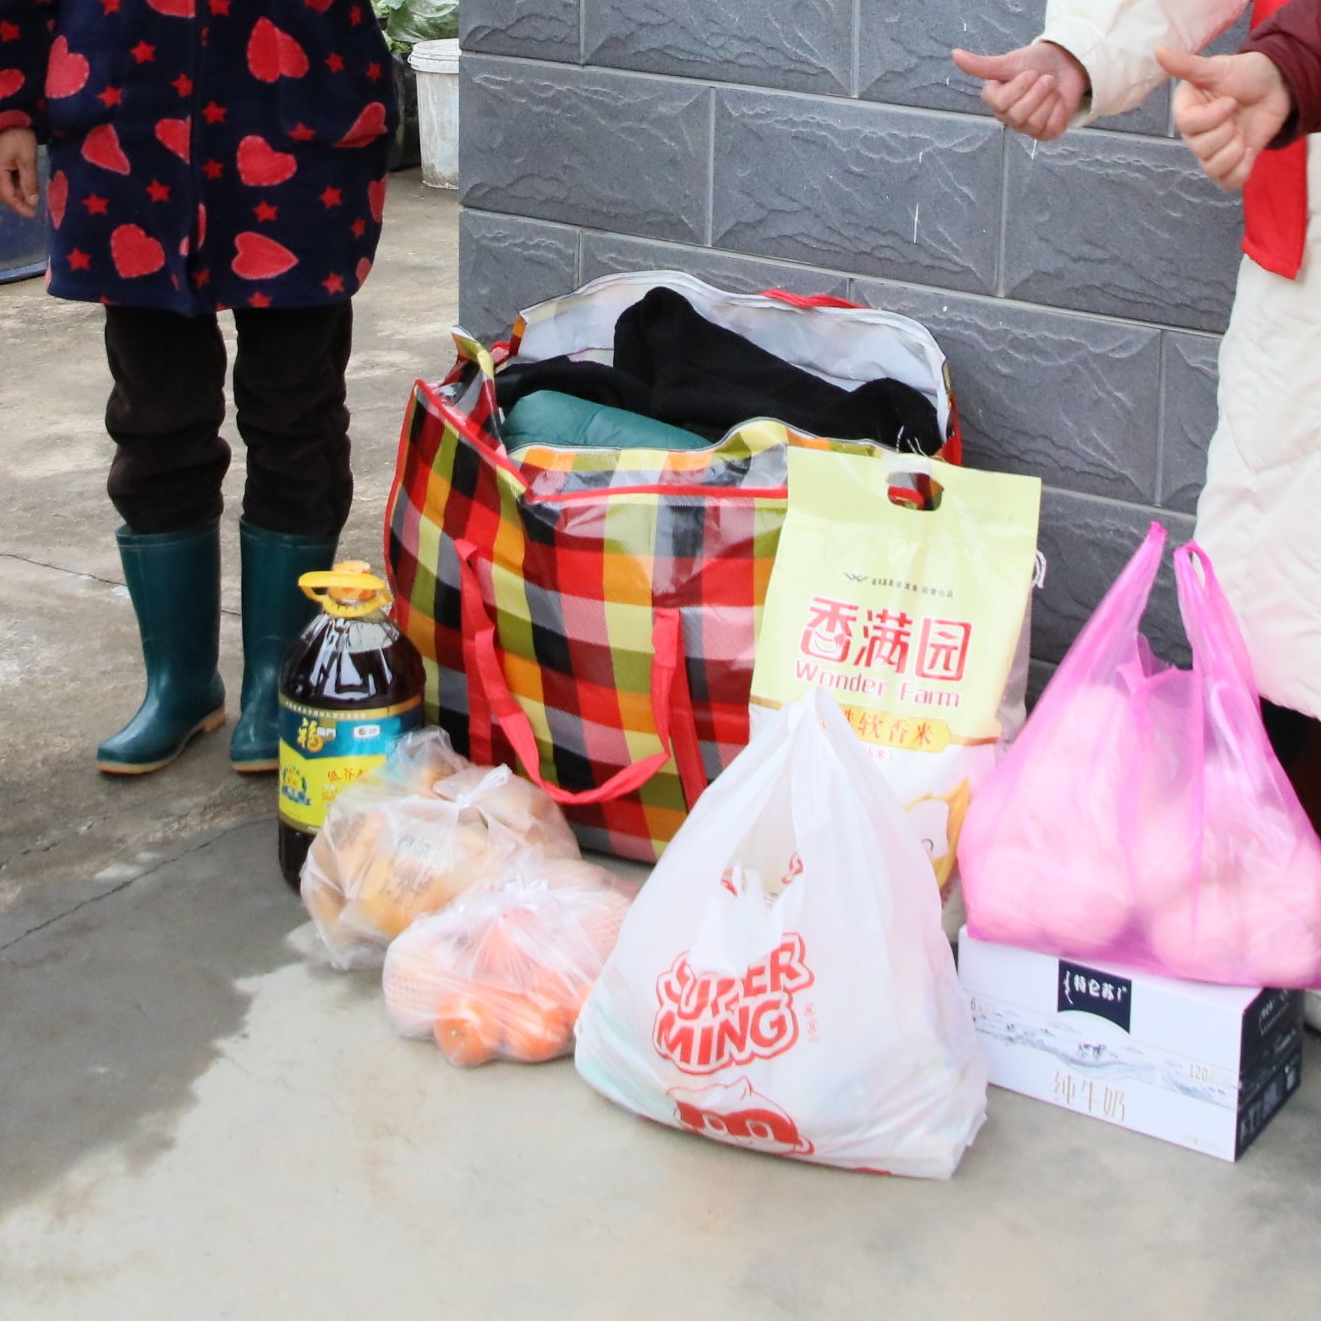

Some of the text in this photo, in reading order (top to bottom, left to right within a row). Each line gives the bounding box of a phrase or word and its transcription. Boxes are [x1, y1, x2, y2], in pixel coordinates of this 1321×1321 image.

[799, 595, 973, 682] 香满园
[795, 659, 961, 708] Wonder Farm
[656, 998, 788, 1066] MING
[1053, 1069, 1126, 1123] 纯牛奶
